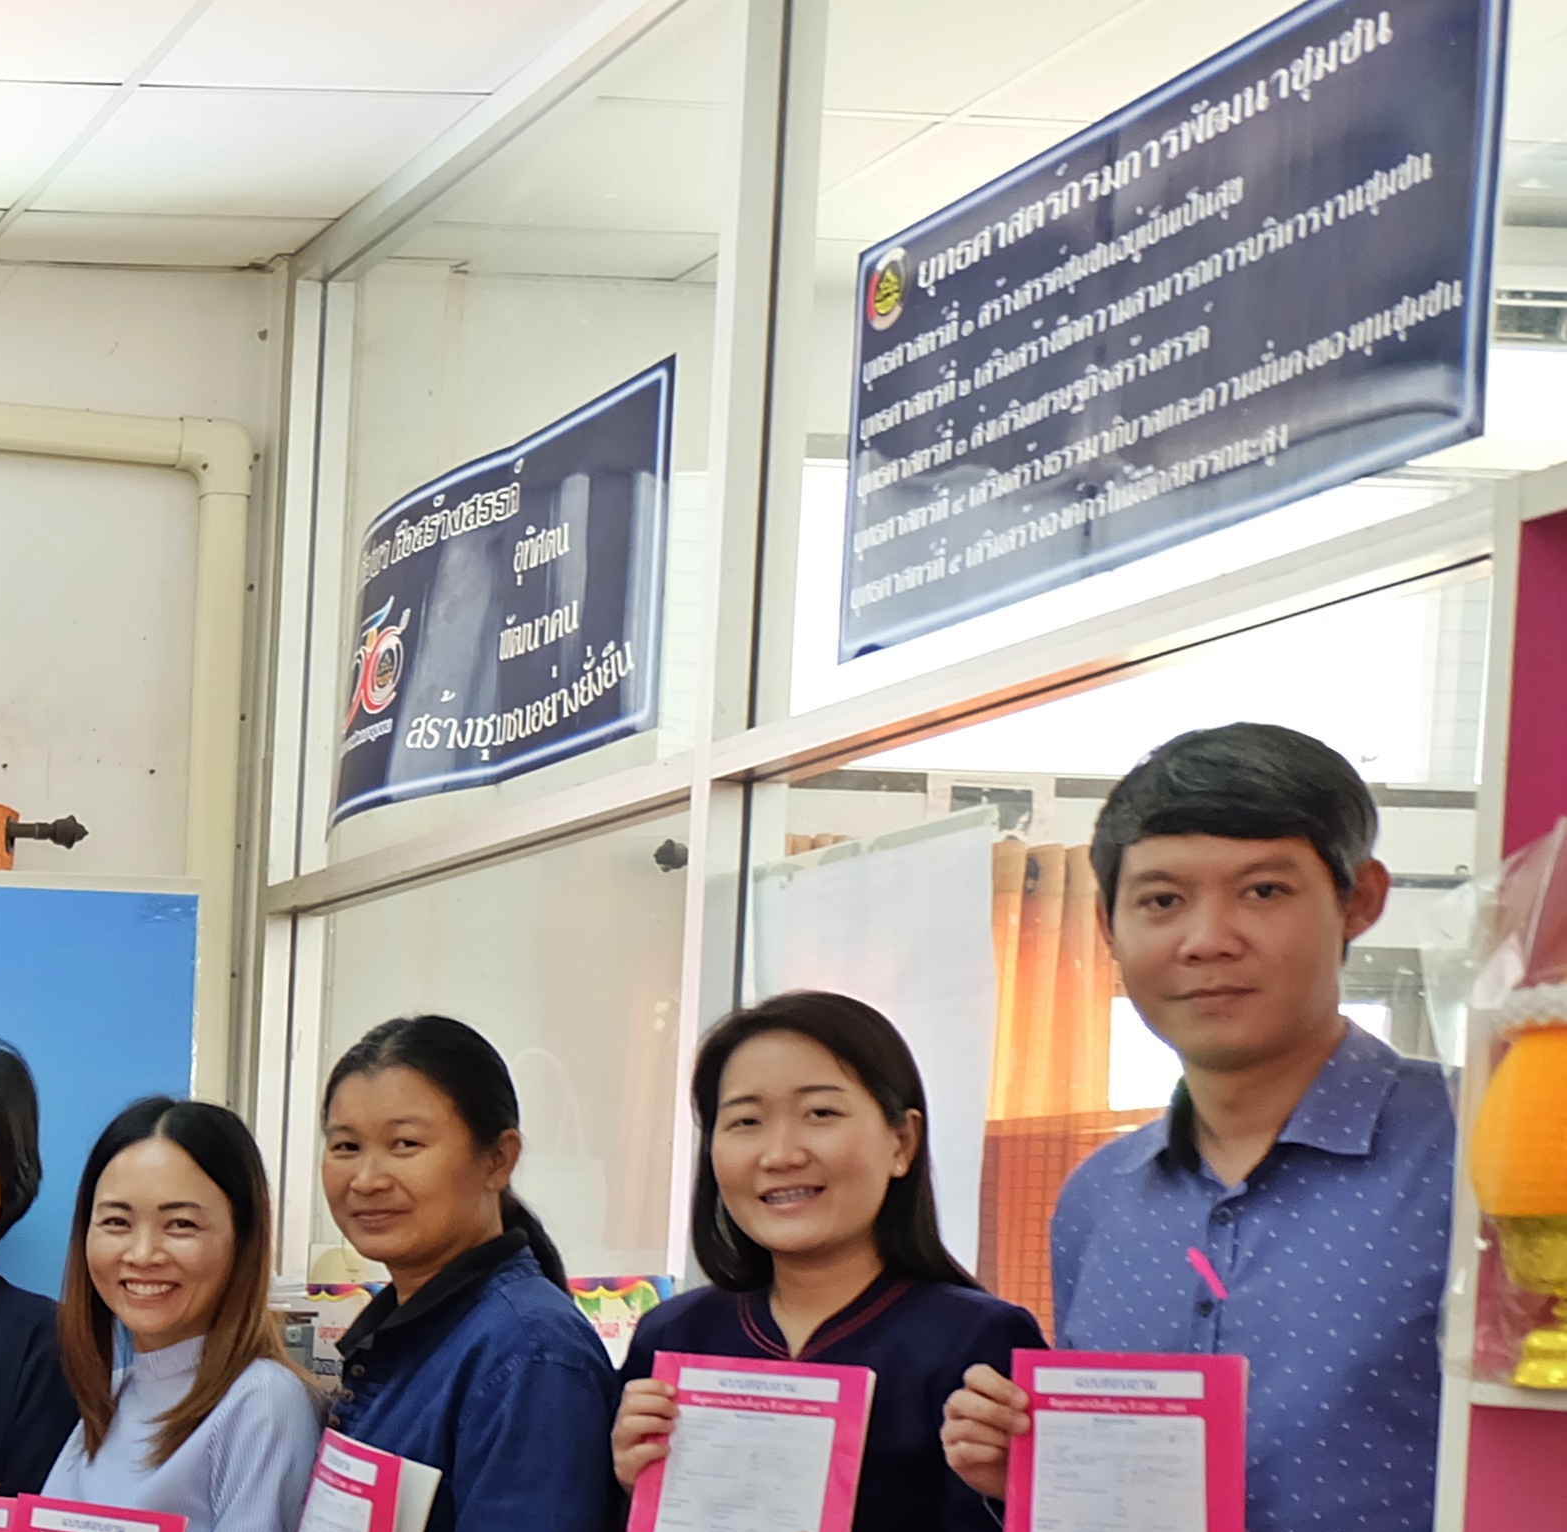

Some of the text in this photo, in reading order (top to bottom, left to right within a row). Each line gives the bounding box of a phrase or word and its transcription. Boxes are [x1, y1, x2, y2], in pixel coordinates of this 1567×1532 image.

[918, 11, 1393, 296] ยุทธศาสตร์กรมการพัฒนาชุมชน
[513, 522, 571, 586] อุทิศตน
[499, 600, 579, 661] พัฒนาคน
[405, 640, 635, 761] สร้างชุมชนอย่างยั่งยืน
